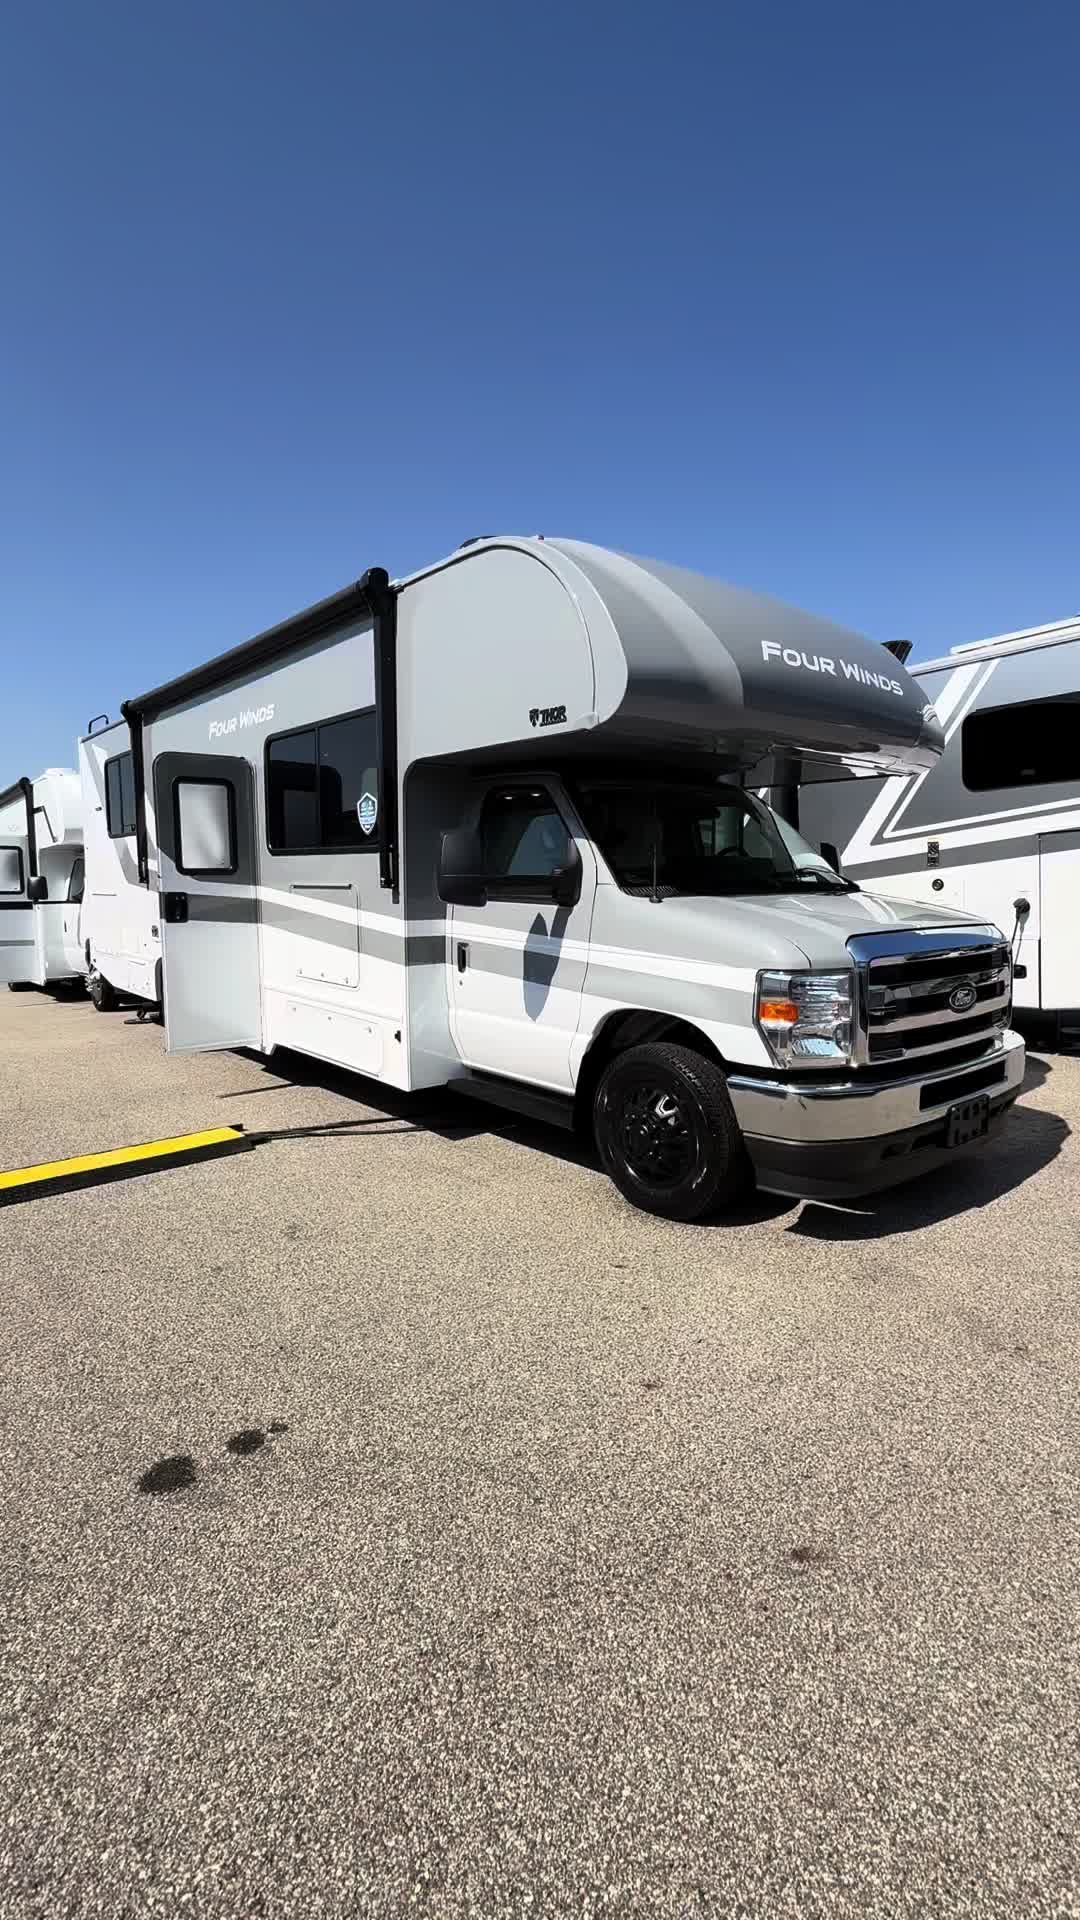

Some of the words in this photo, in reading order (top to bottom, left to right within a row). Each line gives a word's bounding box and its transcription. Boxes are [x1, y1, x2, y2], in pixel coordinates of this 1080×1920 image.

[761, 640, 837, 676] FOUR
[840, 659, 904, 696] WINDS
[208, 717, 237, 741] FOUR
[240, 703, 275, 728] WINDS
[540, 705, 567, 727] THOR
